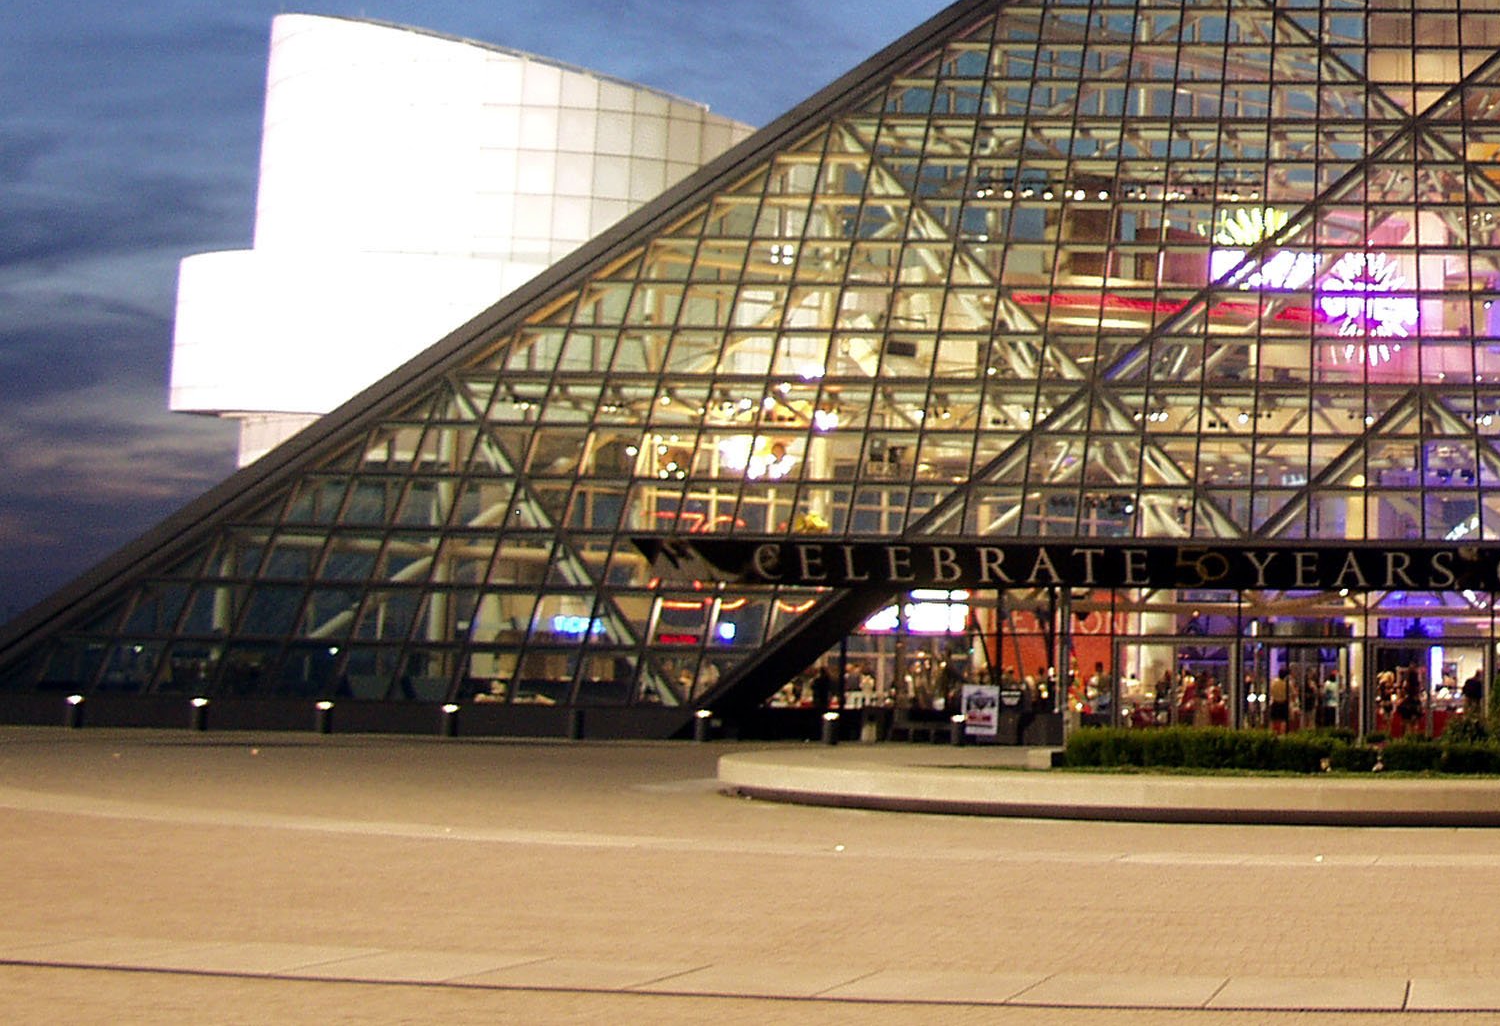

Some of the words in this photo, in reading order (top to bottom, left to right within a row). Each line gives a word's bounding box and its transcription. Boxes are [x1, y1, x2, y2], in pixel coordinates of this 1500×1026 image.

[754, 543, 1150, 584] CELEBRATE
[1175, 546, 1230, 587] 50
[1243, 551, 1456, 587] YEARS
